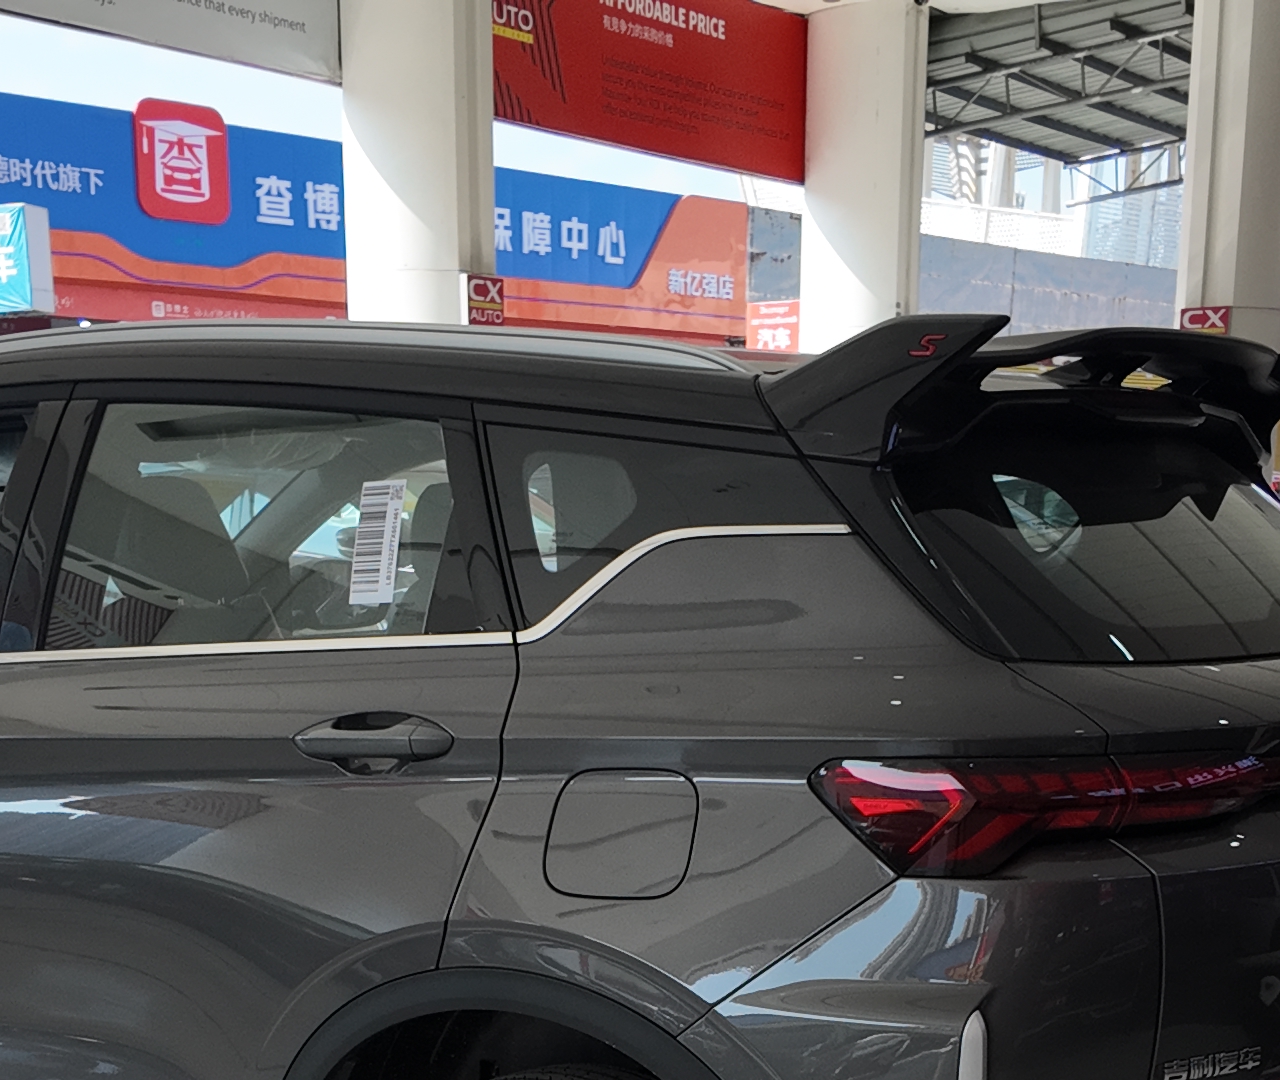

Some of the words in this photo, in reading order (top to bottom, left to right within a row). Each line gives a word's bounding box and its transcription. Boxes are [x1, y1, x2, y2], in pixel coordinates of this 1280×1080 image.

[228, 5, 256, 24] every
[259, 10, 306, 33] shipment
[493, 1, 534, 31] UTO
[598, 0, 687, 29] ORDABLE
[689, 10, 726, 40] PRICE
[470, 279, 502, 303] CX
[668, 268, 735, 300] 新亿强店
[471, 308, 503, 324] AUTO
[1182, 308, 1227, 329] CX
